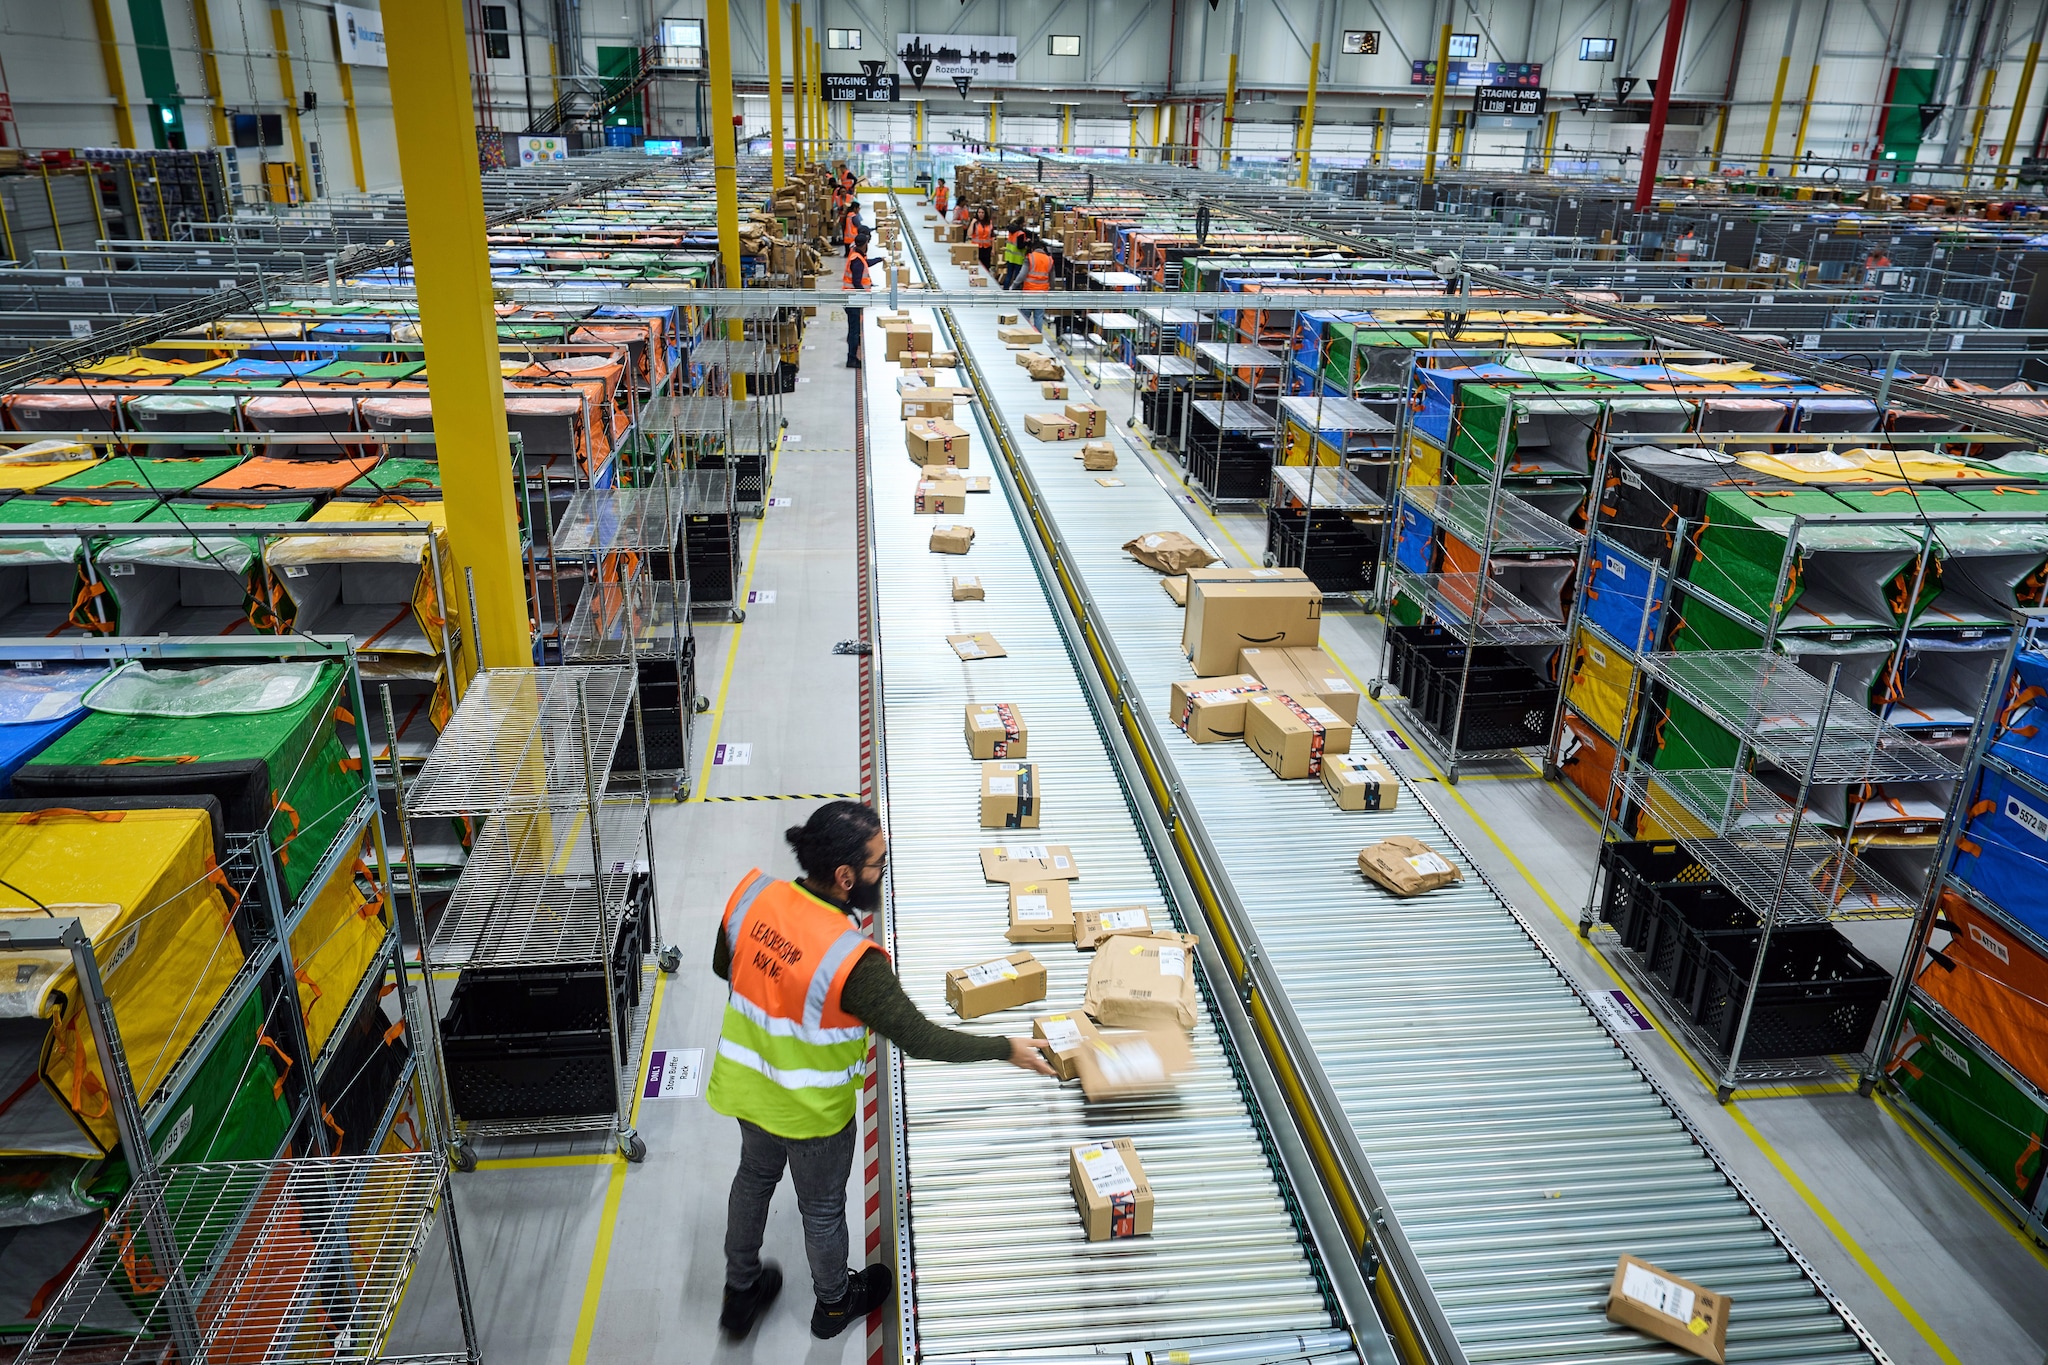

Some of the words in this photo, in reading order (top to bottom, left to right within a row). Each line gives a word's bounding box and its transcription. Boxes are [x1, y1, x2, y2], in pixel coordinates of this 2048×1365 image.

[912, 65, 923, 77] C
[935, 66, 979, 76] Rozenburg
[827, 77, 867, 86] STAGING
[868, 77, 893, 86] EA
[1621, 81, 1631, 93] B
[1481, 89, 1518, 99] STAGING
[1518, 90, 1541, 100] AREA
[1789, 260, 1797, 269] 24
[1999, 295, 2010, 306] 21
[2019, 809, 2037, 829] 5572
[750, 919, 803, 966] LEADERSHIP
[1623, 1003, 1640, 1017] DNL1
[669, 1056, 679, 1074] Buffer
[650, 1066, 661, 1082] DNL1
[680, 1065, 689, 1080] Rack
[666, 1075, 676, 1091] Stow
